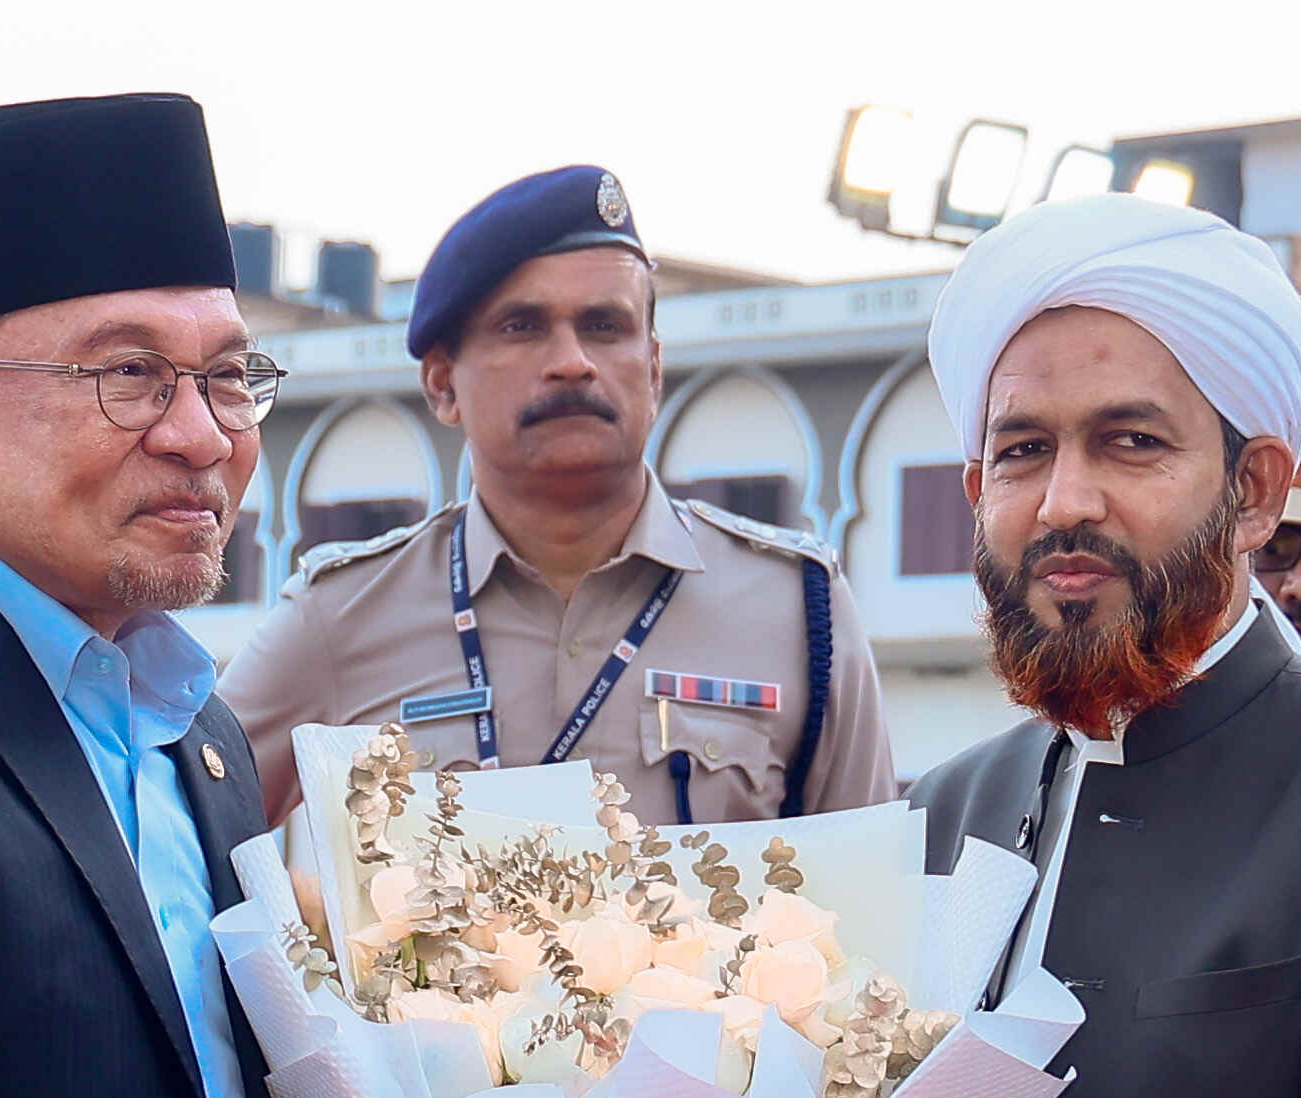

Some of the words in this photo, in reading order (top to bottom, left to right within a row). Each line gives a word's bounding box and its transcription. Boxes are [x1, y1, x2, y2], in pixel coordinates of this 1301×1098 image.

[469, 656, 483, 689] OLICE
[552, 718, 586, 760] KERALA
[581, 677, 611, 716] POLICE
